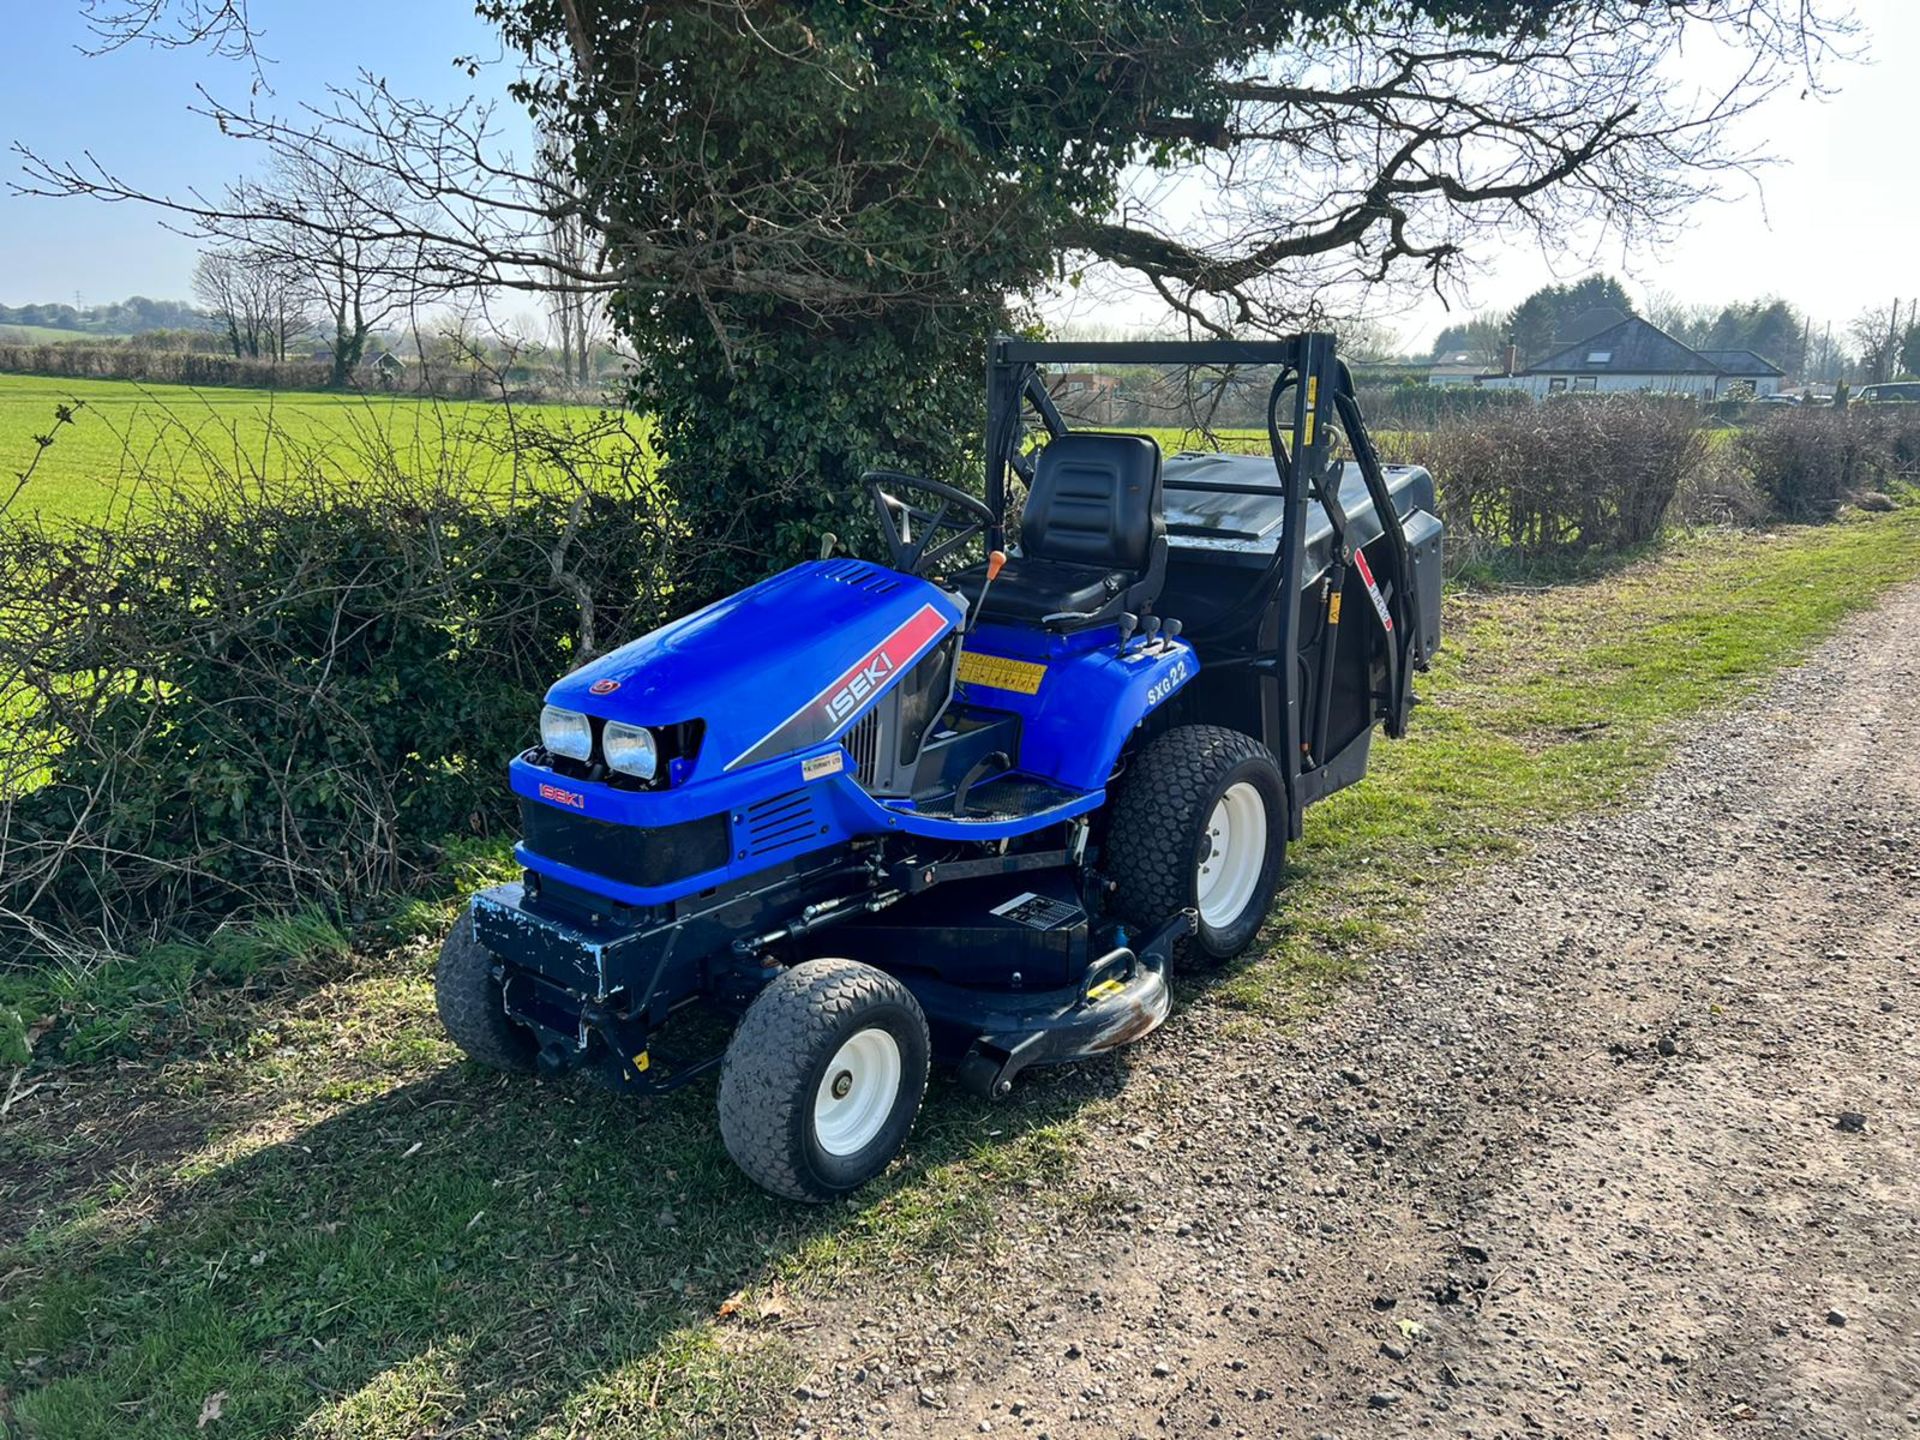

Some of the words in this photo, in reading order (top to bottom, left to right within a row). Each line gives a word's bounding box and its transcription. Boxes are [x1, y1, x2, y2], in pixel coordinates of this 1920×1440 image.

[825, 652, 893, 723] ISEKI
[1147, 661, 1187, 705] SXG22
[539, 783, 584, 809] ISEKI
